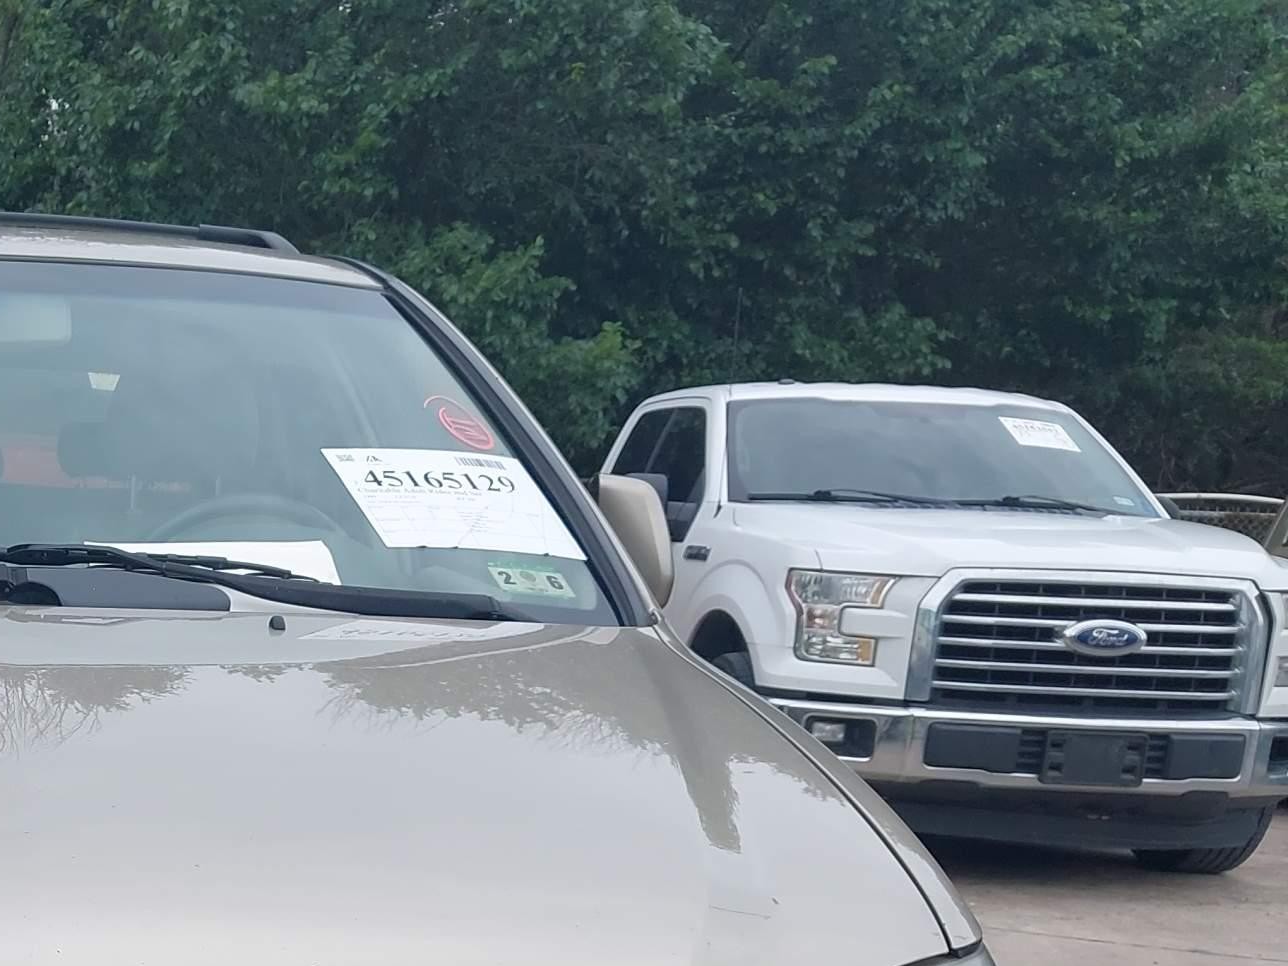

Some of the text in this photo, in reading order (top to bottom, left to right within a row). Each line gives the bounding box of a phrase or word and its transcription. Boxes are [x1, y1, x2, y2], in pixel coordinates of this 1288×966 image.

[364, 469, 515, 493] 45165129
[497, 570, 517, 585] 2
[545, 575, 564, 590] 6
[1088, 628, 1129, 646] Ford
